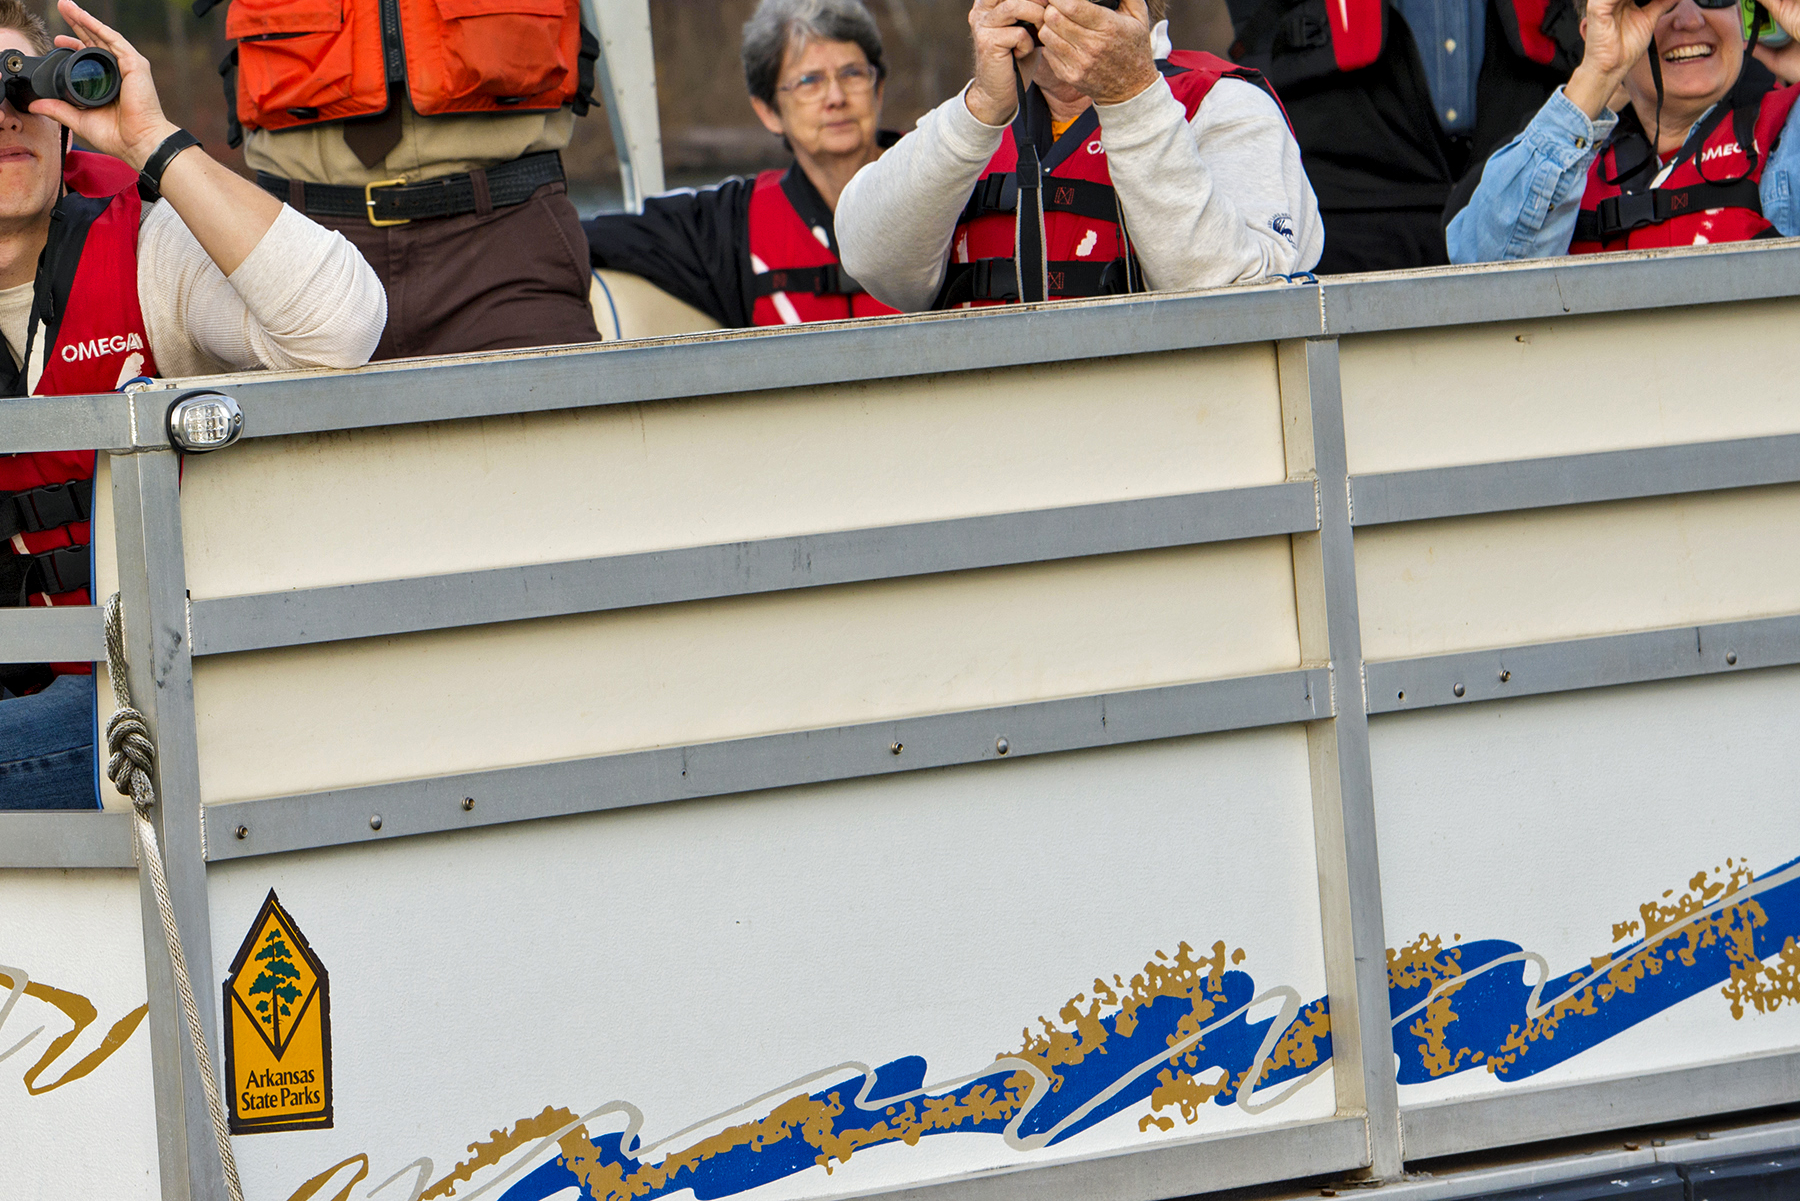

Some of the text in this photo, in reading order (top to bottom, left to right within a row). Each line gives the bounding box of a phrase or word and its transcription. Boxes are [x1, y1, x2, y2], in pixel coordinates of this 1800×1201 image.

[61, 332, 144, 362] OMEGA
[245, 1067, 315, 1089] Arkansas
[241, 1088, 321, 1111] State Parks
